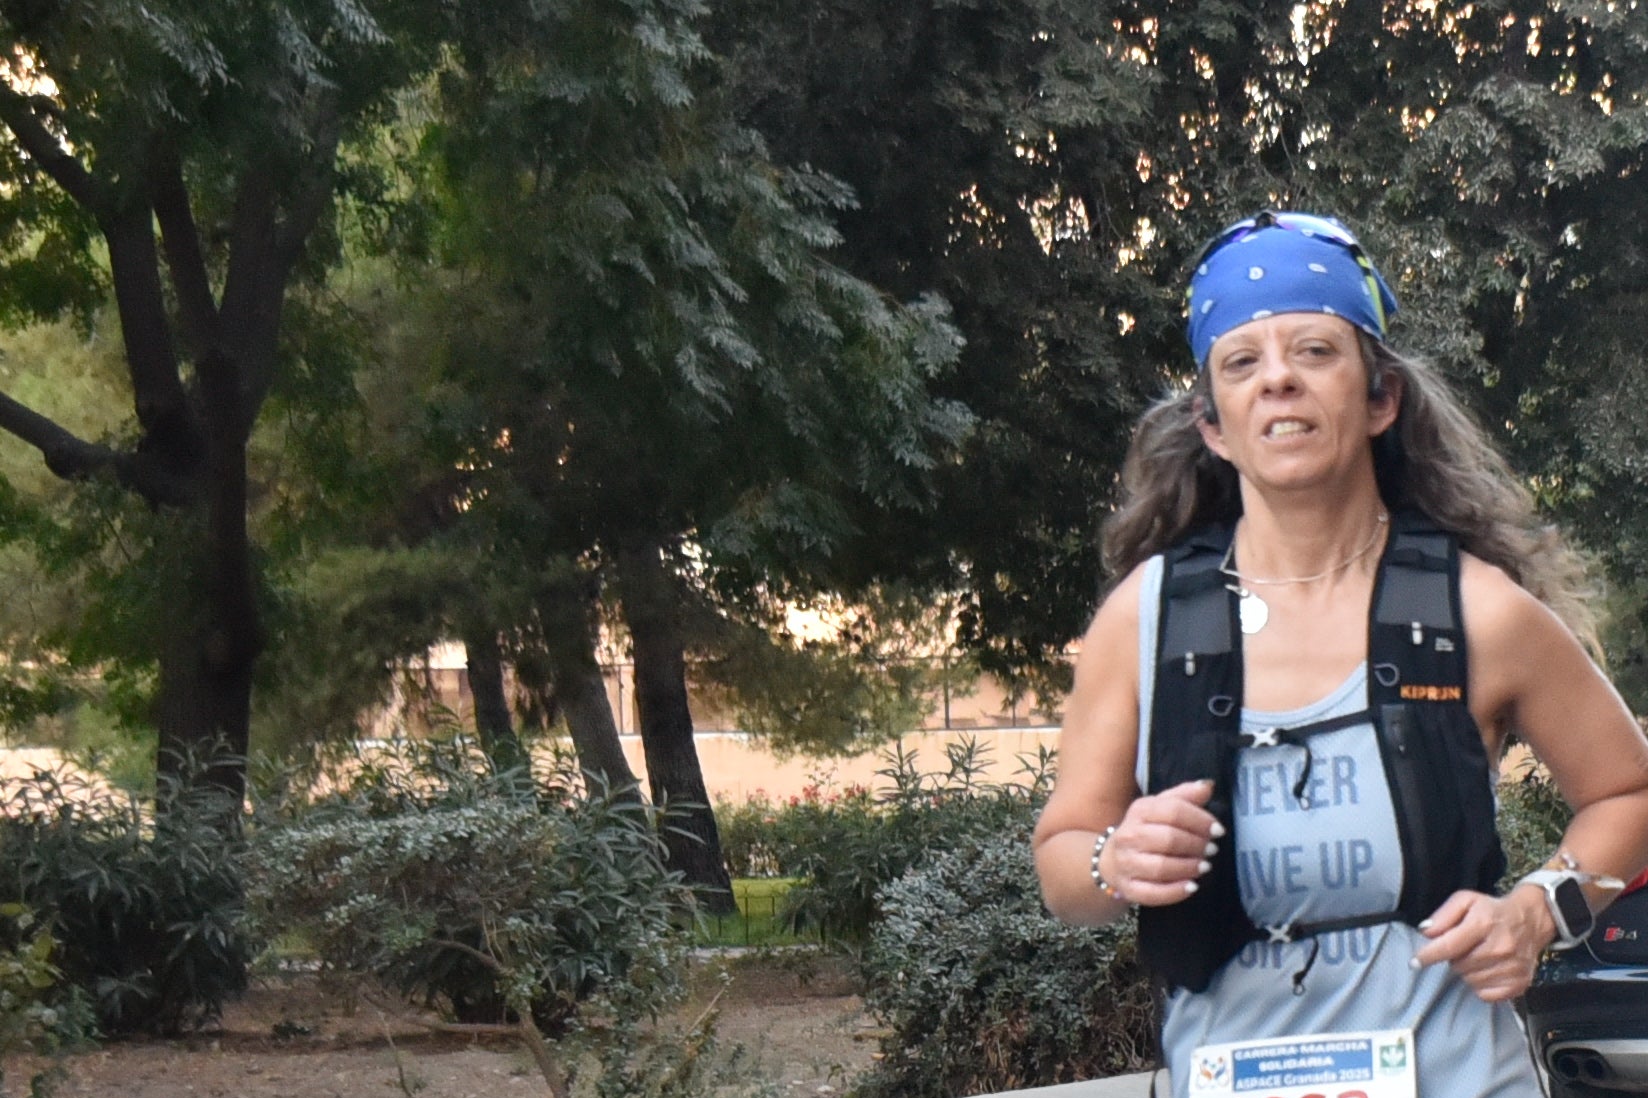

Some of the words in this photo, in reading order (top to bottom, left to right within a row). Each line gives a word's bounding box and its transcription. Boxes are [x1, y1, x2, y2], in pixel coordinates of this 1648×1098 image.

[1401, 685, 1462, 700] KIPRUN
[1239, 844, 1309, 899] IVE
[1319, 839, 1374, 890] UP
[1303, 926, 1372, 967] OU
[1258, 1056, 1335, 1072] SOLIDARIA
[1235, 1074, 1282, 1090] ASPACE
[1283, 1070, 1338, 1085] Granada
[1339, 1067, 1371, 1081] 2025
